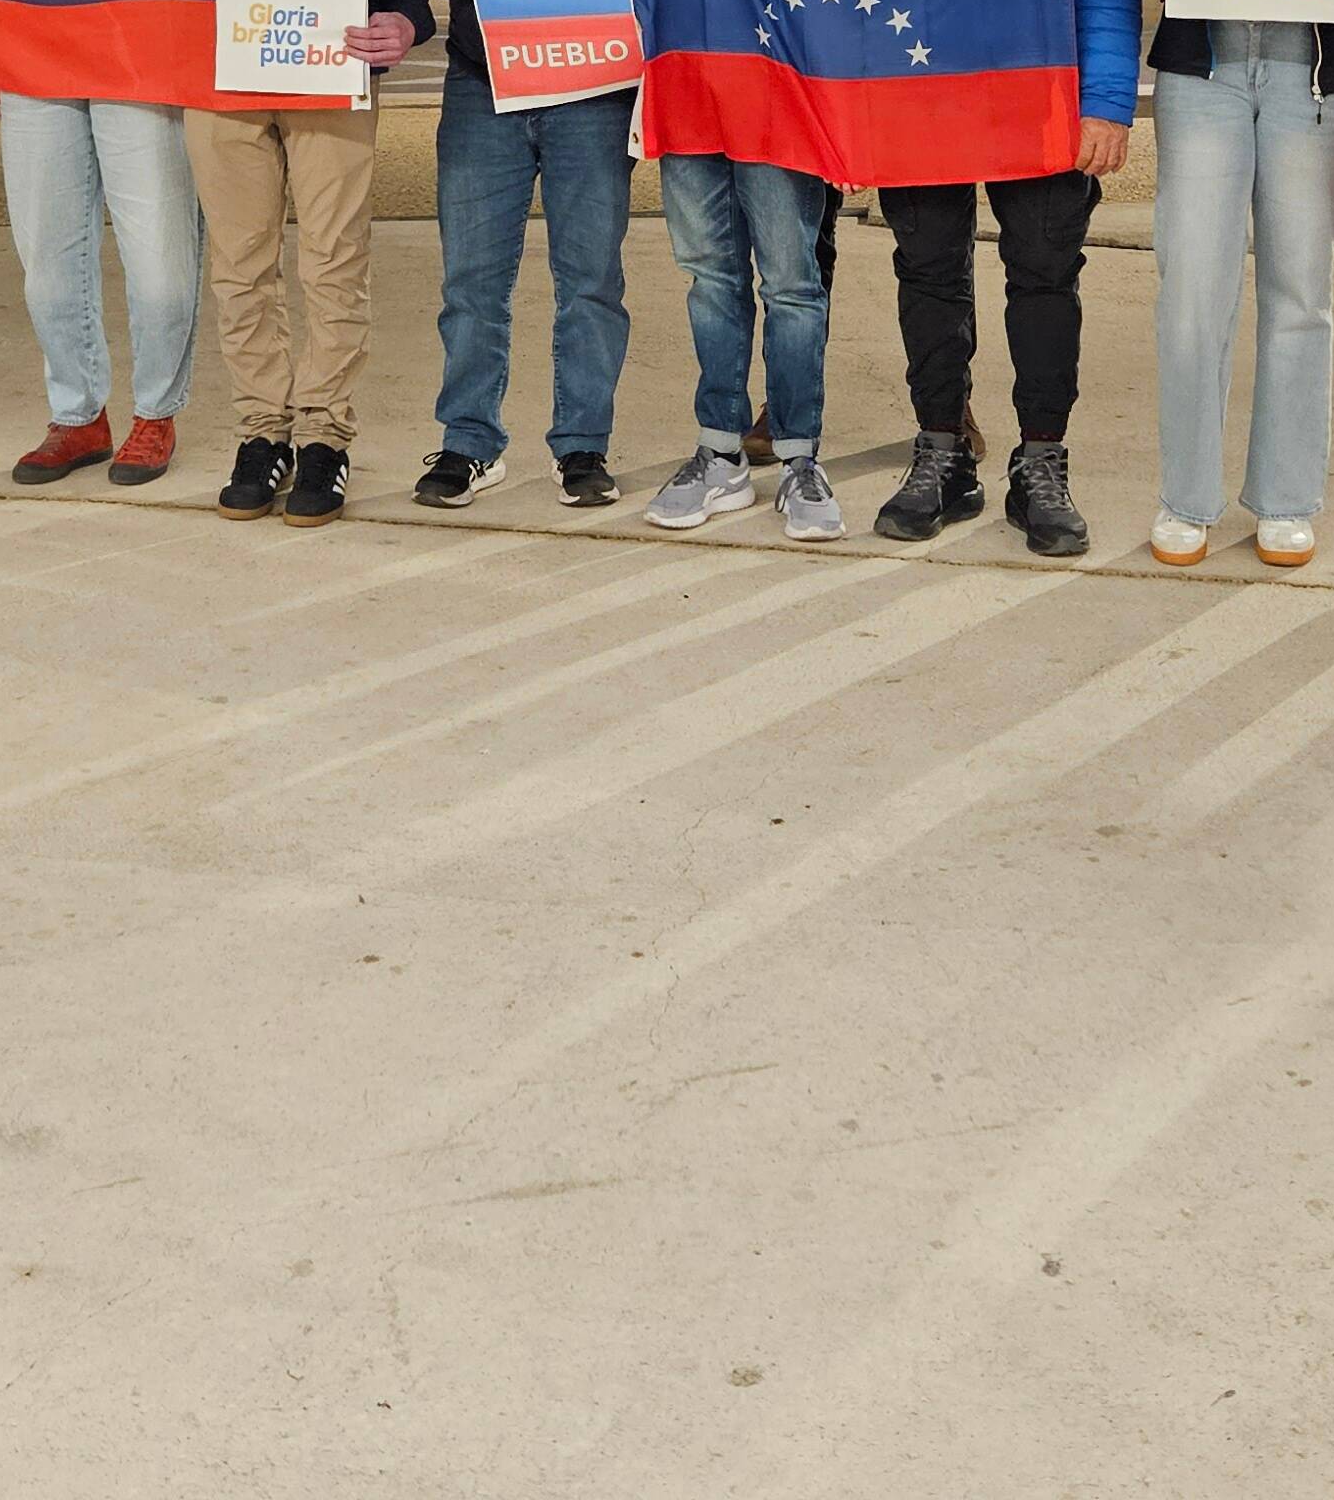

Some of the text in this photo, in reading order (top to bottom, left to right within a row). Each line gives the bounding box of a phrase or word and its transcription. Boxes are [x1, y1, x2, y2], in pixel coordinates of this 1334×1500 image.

[249, 3, 318, 28] Gloria
[232, 21, 302, 46] bravo
[260, 44, 348, 67] pueblo
[500, 39, 629, 70] PUEBLO
